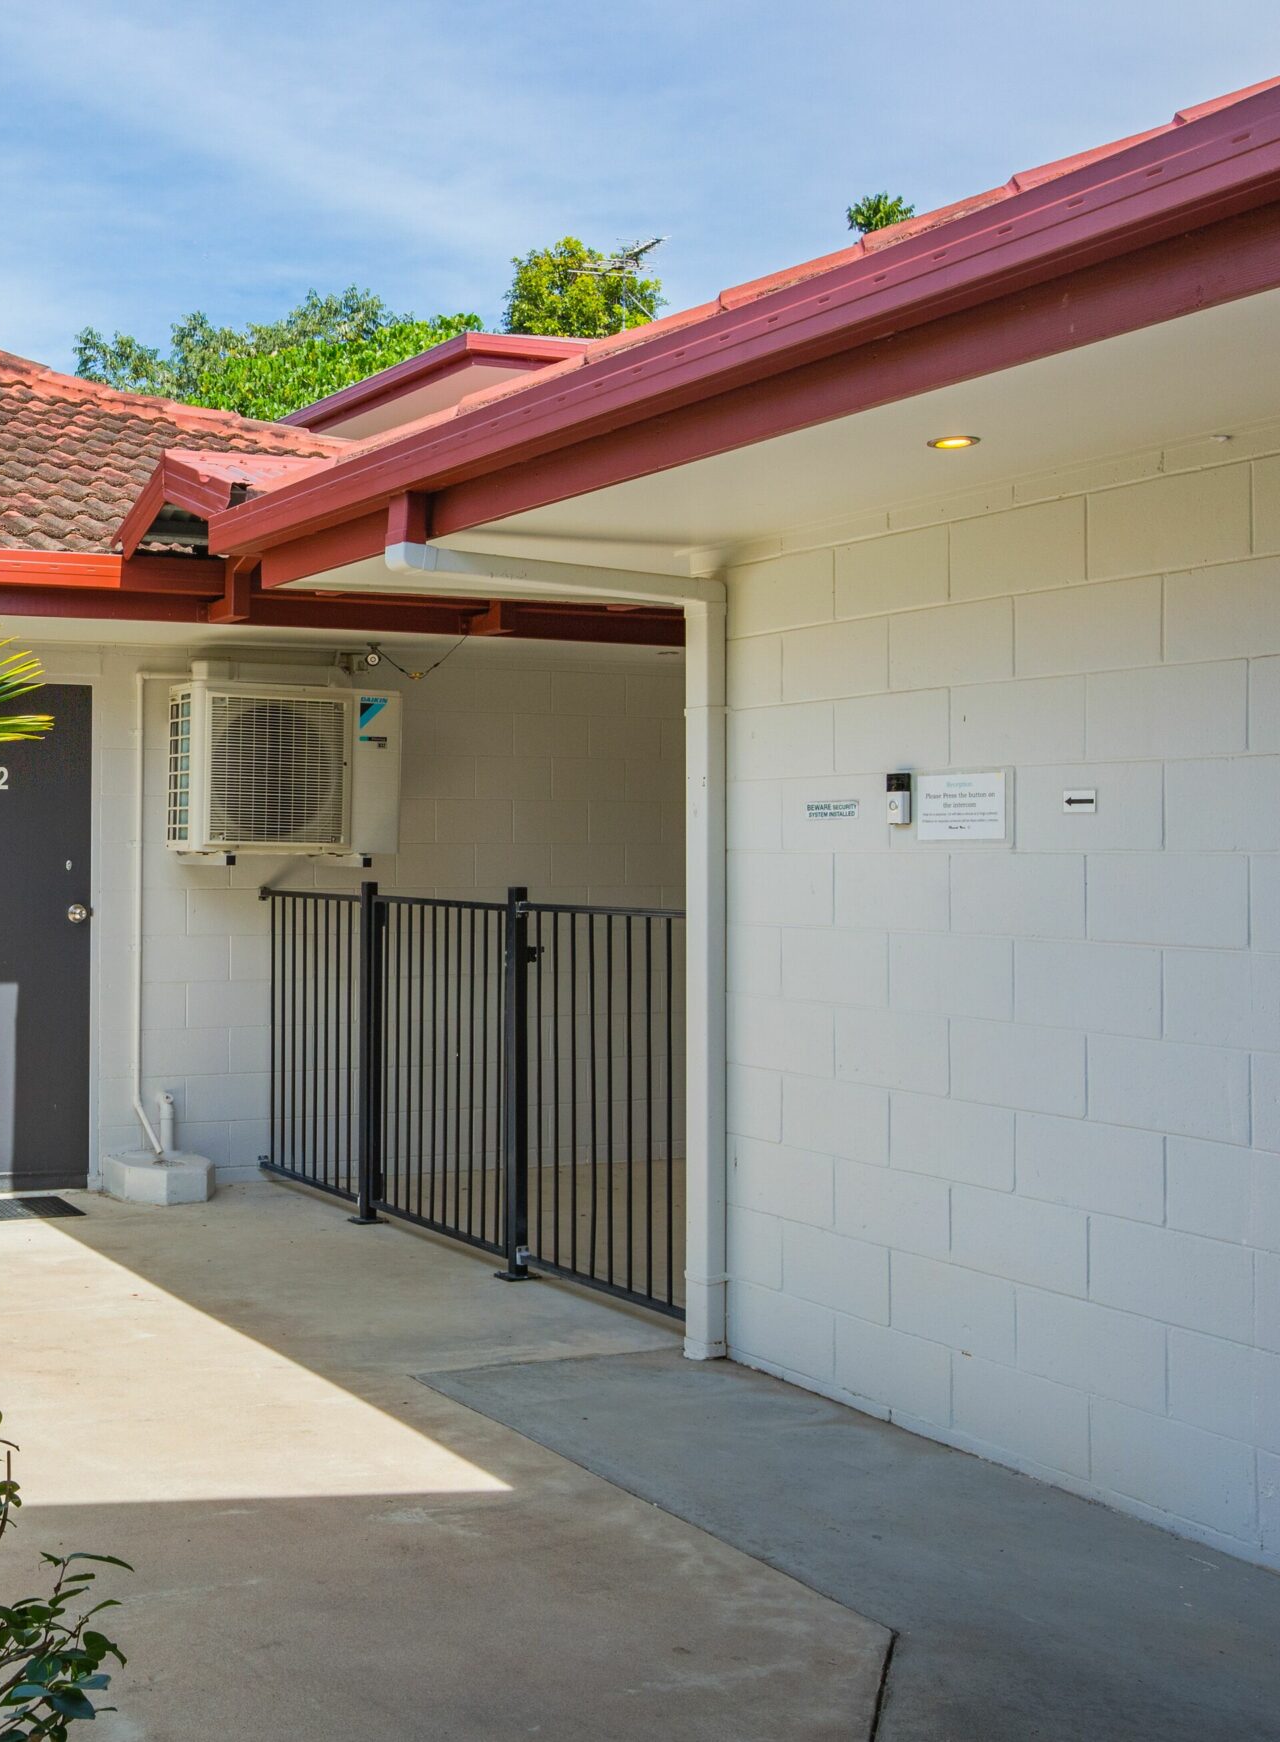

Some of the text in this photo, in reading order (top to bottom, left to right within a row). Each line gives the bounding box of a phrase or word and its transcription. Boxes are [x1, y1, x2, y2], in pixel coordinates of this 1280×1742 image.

[360, 696, 388, 704] DAIKIN
[958, 791, 967, 799] the
[806, 803, 857, 811] BEWARE SECURITY
